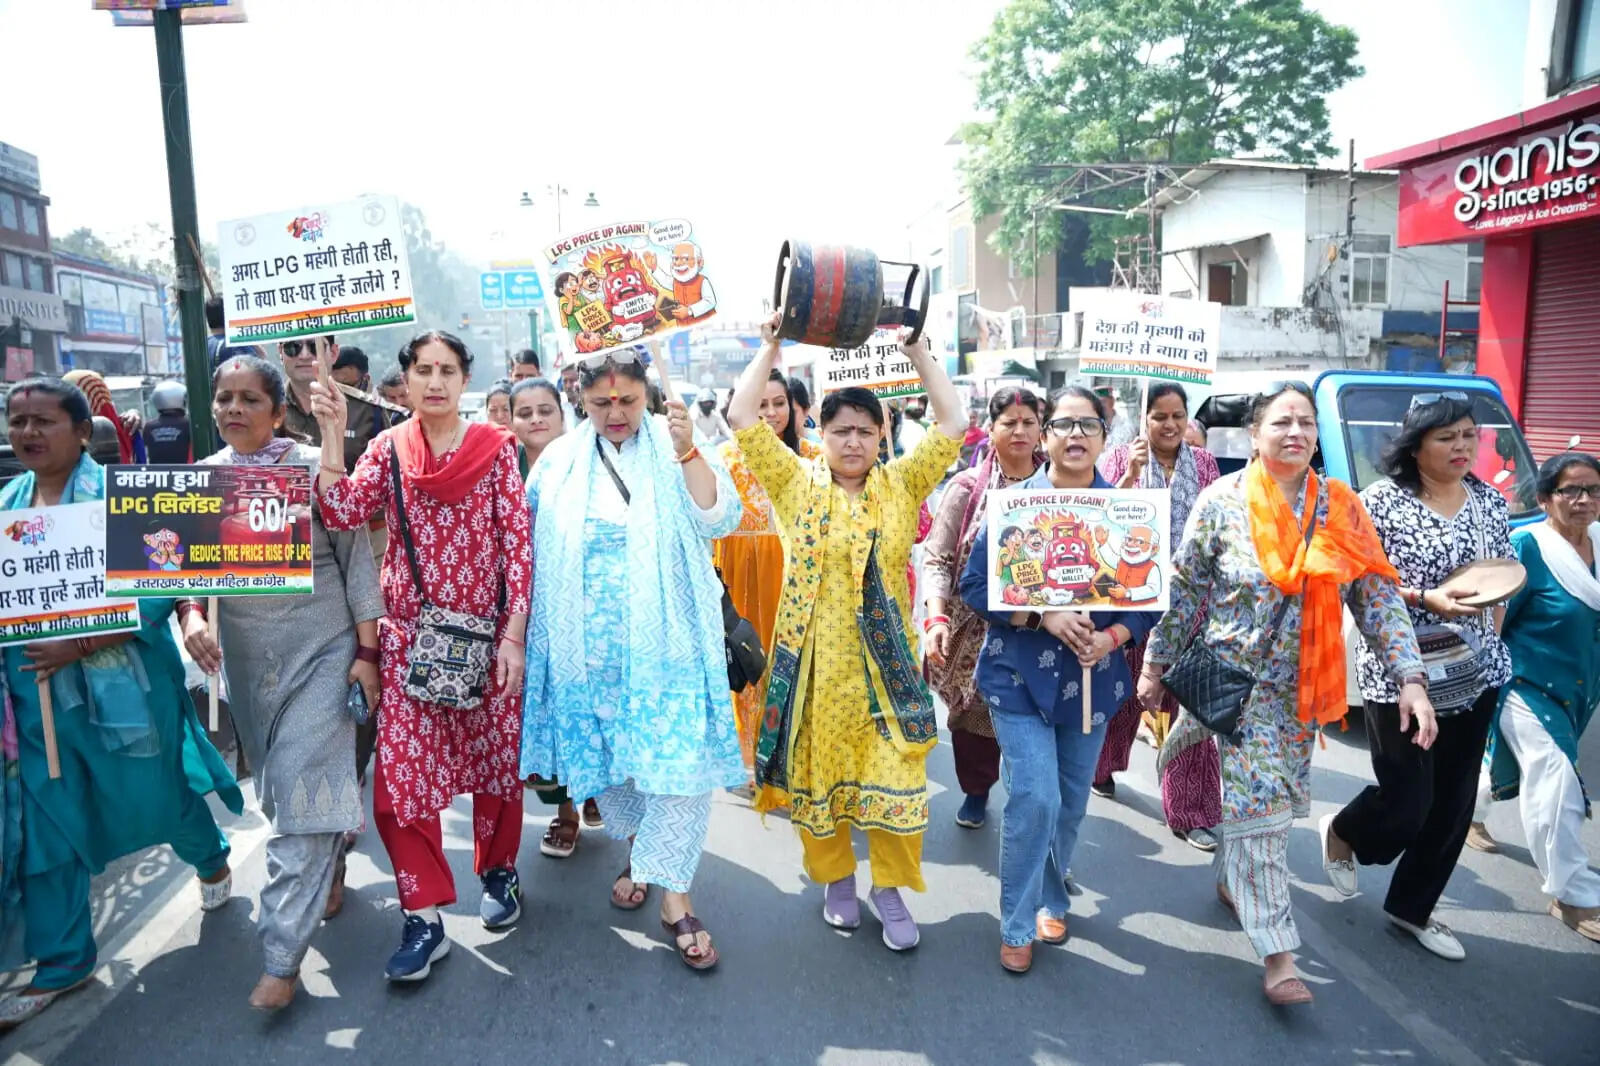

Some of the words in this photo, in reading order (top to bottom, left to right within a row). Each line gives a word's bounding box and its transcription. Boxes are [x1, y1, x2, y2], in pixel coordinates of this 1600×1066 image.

[1496, 212, 1527, 226] Legacy
[1536, 208, 1550, 219] Ice
[1551, 202, 1588, 216] Creams
[551, 241, 571, 257] LPG
[572, 230, 601, 247] PRICE
[602, 227, 614, 238] UP
[615, 223, 645, 235] AGAIN!
[653, 227, 669, 235] Good
[231, 262, 259, 282] अगर
[264, 255, 299, 277] LPG
[304, 245, 337, 270] महंगी
[341, 241, 369, 266] होती
[235, 288, 249, 311] तो
[254, 289, 276, 308] क्या
[280, 283, 316, 304] घर-घर
[349, 269, 385, 294] जलेंगे
[392, 270, 400, 290] ?
[580, 305, 598, 318] LPG
[625, 297, 645, 310] EMPTY
[626, 304, 648, 316] WALLET
[328, 308, 366, 325] महिला
[370, 303, 406, 323] कांग्रेस
[582, 310, 603, 325] PRICE
[587, 316, 606, 331] HIKE!
[1095, 319, 1118, 334] देश
[1121, 321, 1139, 334] की
[1187, 328, 1207, 343] को
[828, 348, 850, 362] देश
[854, 344, 871, 359] की
[1088, 338, 1134, 355] महंगाई
[1139, 340, 1152, 354] से
[1156, 345, 1188, 360] न्याय
[1193, 348, 1208, 362] दो
[828, 363, 870, 382] महंगाई
[875, 361, 886, 376] से
[115, 467, 170, 488] महंगा
[172, 470, 211, 492] हुआ
[109, 496, 148, 514] LPG
[151, 492, 224, 514] सिलेंडर
[1007, 499, 1027, 509] LPG
[1029, 495, 1057, 507] PRICE
[1059, 494, 1072, 504] UP
[1073, 495, 1106, 508] AGAIN!
[1113, 505, 1130, 513] Good
[1130, 504, 1147, 515] days
[248, 497, 297, 533] 60/-
[22, 549, 60, 575] महंगी
[64, 546, 95, 571] होती
[189, 544, 221, 563] REDUCE
[222, 544, 239, 562] THE
[240, 544, 264, 561] PRICE
[265, 543, 284, 561] RISE
[284, 543, 296, 561] OF
[296, 543, 311, 561] LPG
[1016, 569, 1038, 579] PRICE
[1017, 563, 1035, 572] LPG
[1062, 567, 1083, 575] EMPTY
[133, 577, 185, 589] उत्तराखण्ड
[188, 575, 213, 588] प्रदेश
[215, 573, 249, 587] महिला
[252, 573, 286, 587] कांग्रेस
[1061, 574, 1085, 582] WALLET
[48, 614, 89, 632] महिला
[92, 608, 130, 626] कांग्रेस
